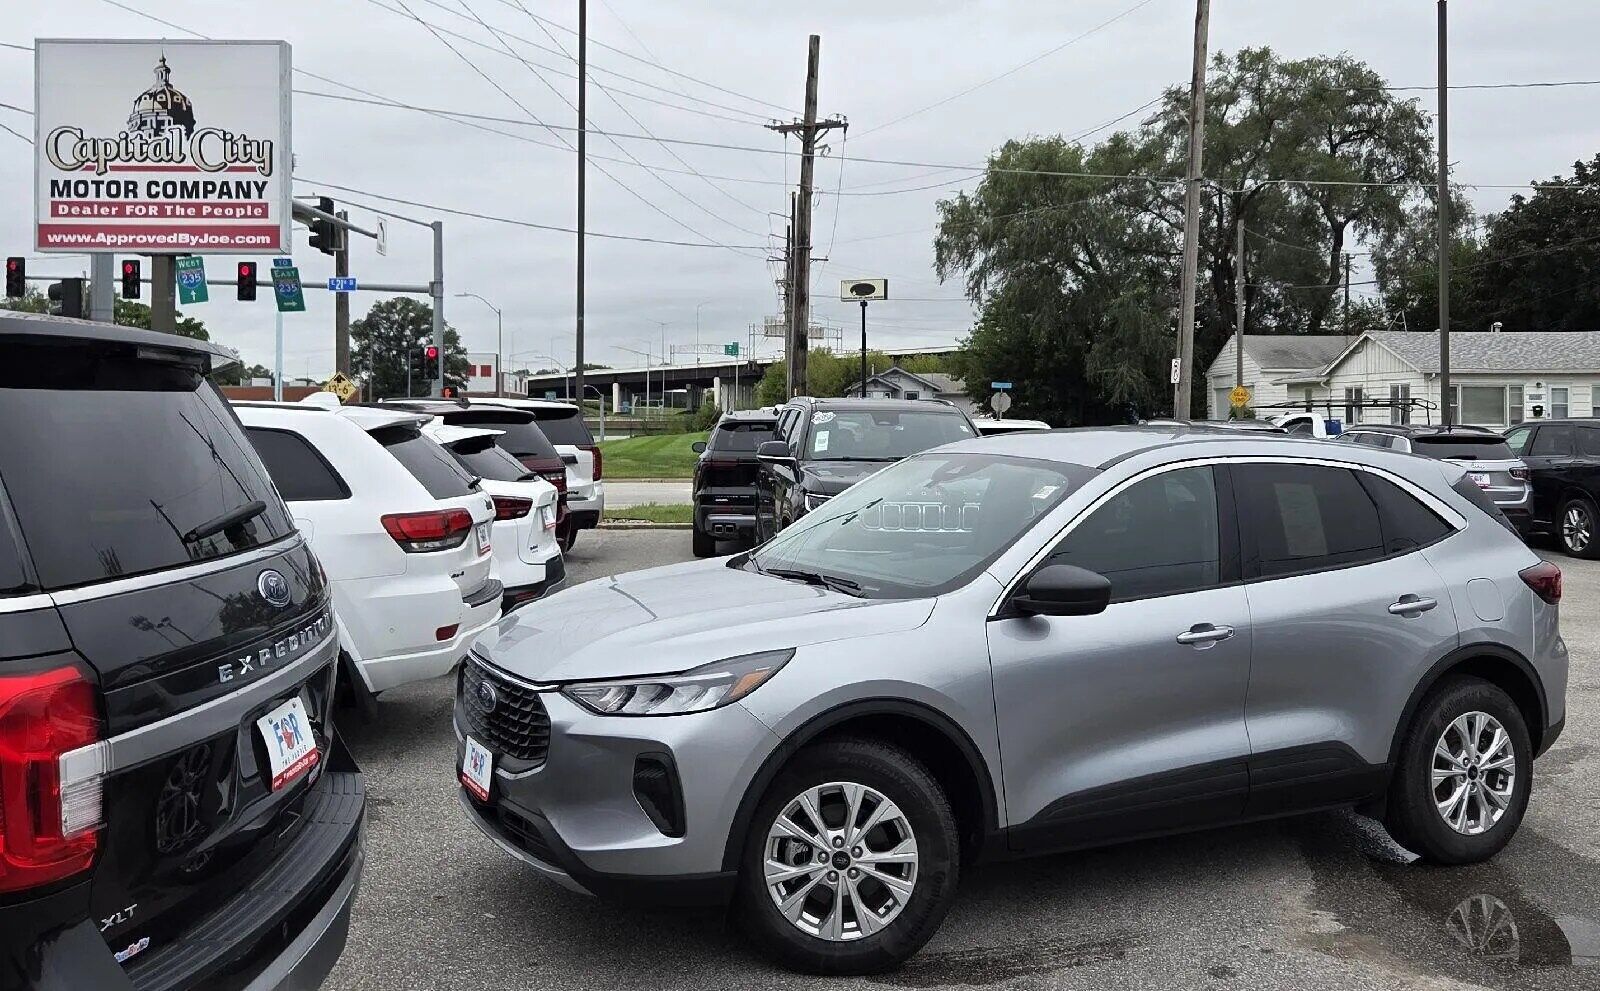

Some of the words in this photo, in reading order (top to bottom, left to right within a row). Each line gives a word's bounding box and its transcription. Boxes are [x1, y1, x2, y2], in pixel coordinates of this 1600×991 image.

[46, 125, 186, 176] Capital
[190, 127, 274, 177] City
[50, 179, 139, 199] MOTOR
[146, 180, 268, 200] COMPANY
[58, 203, 119, 216] Dealer
[125, 205, 159, 216] FOR
[164, 205, 196, 216] The
[202, 206, 263, 218] People
[47, 232, 271, 245] www.ApprovedByJoe.com
[181, 273, 201, 284] 235
[279, 283, 299, 293] 235
[218, 612, 331, 683] EXPEDITION
[100, 903, 138, 932] XLT
